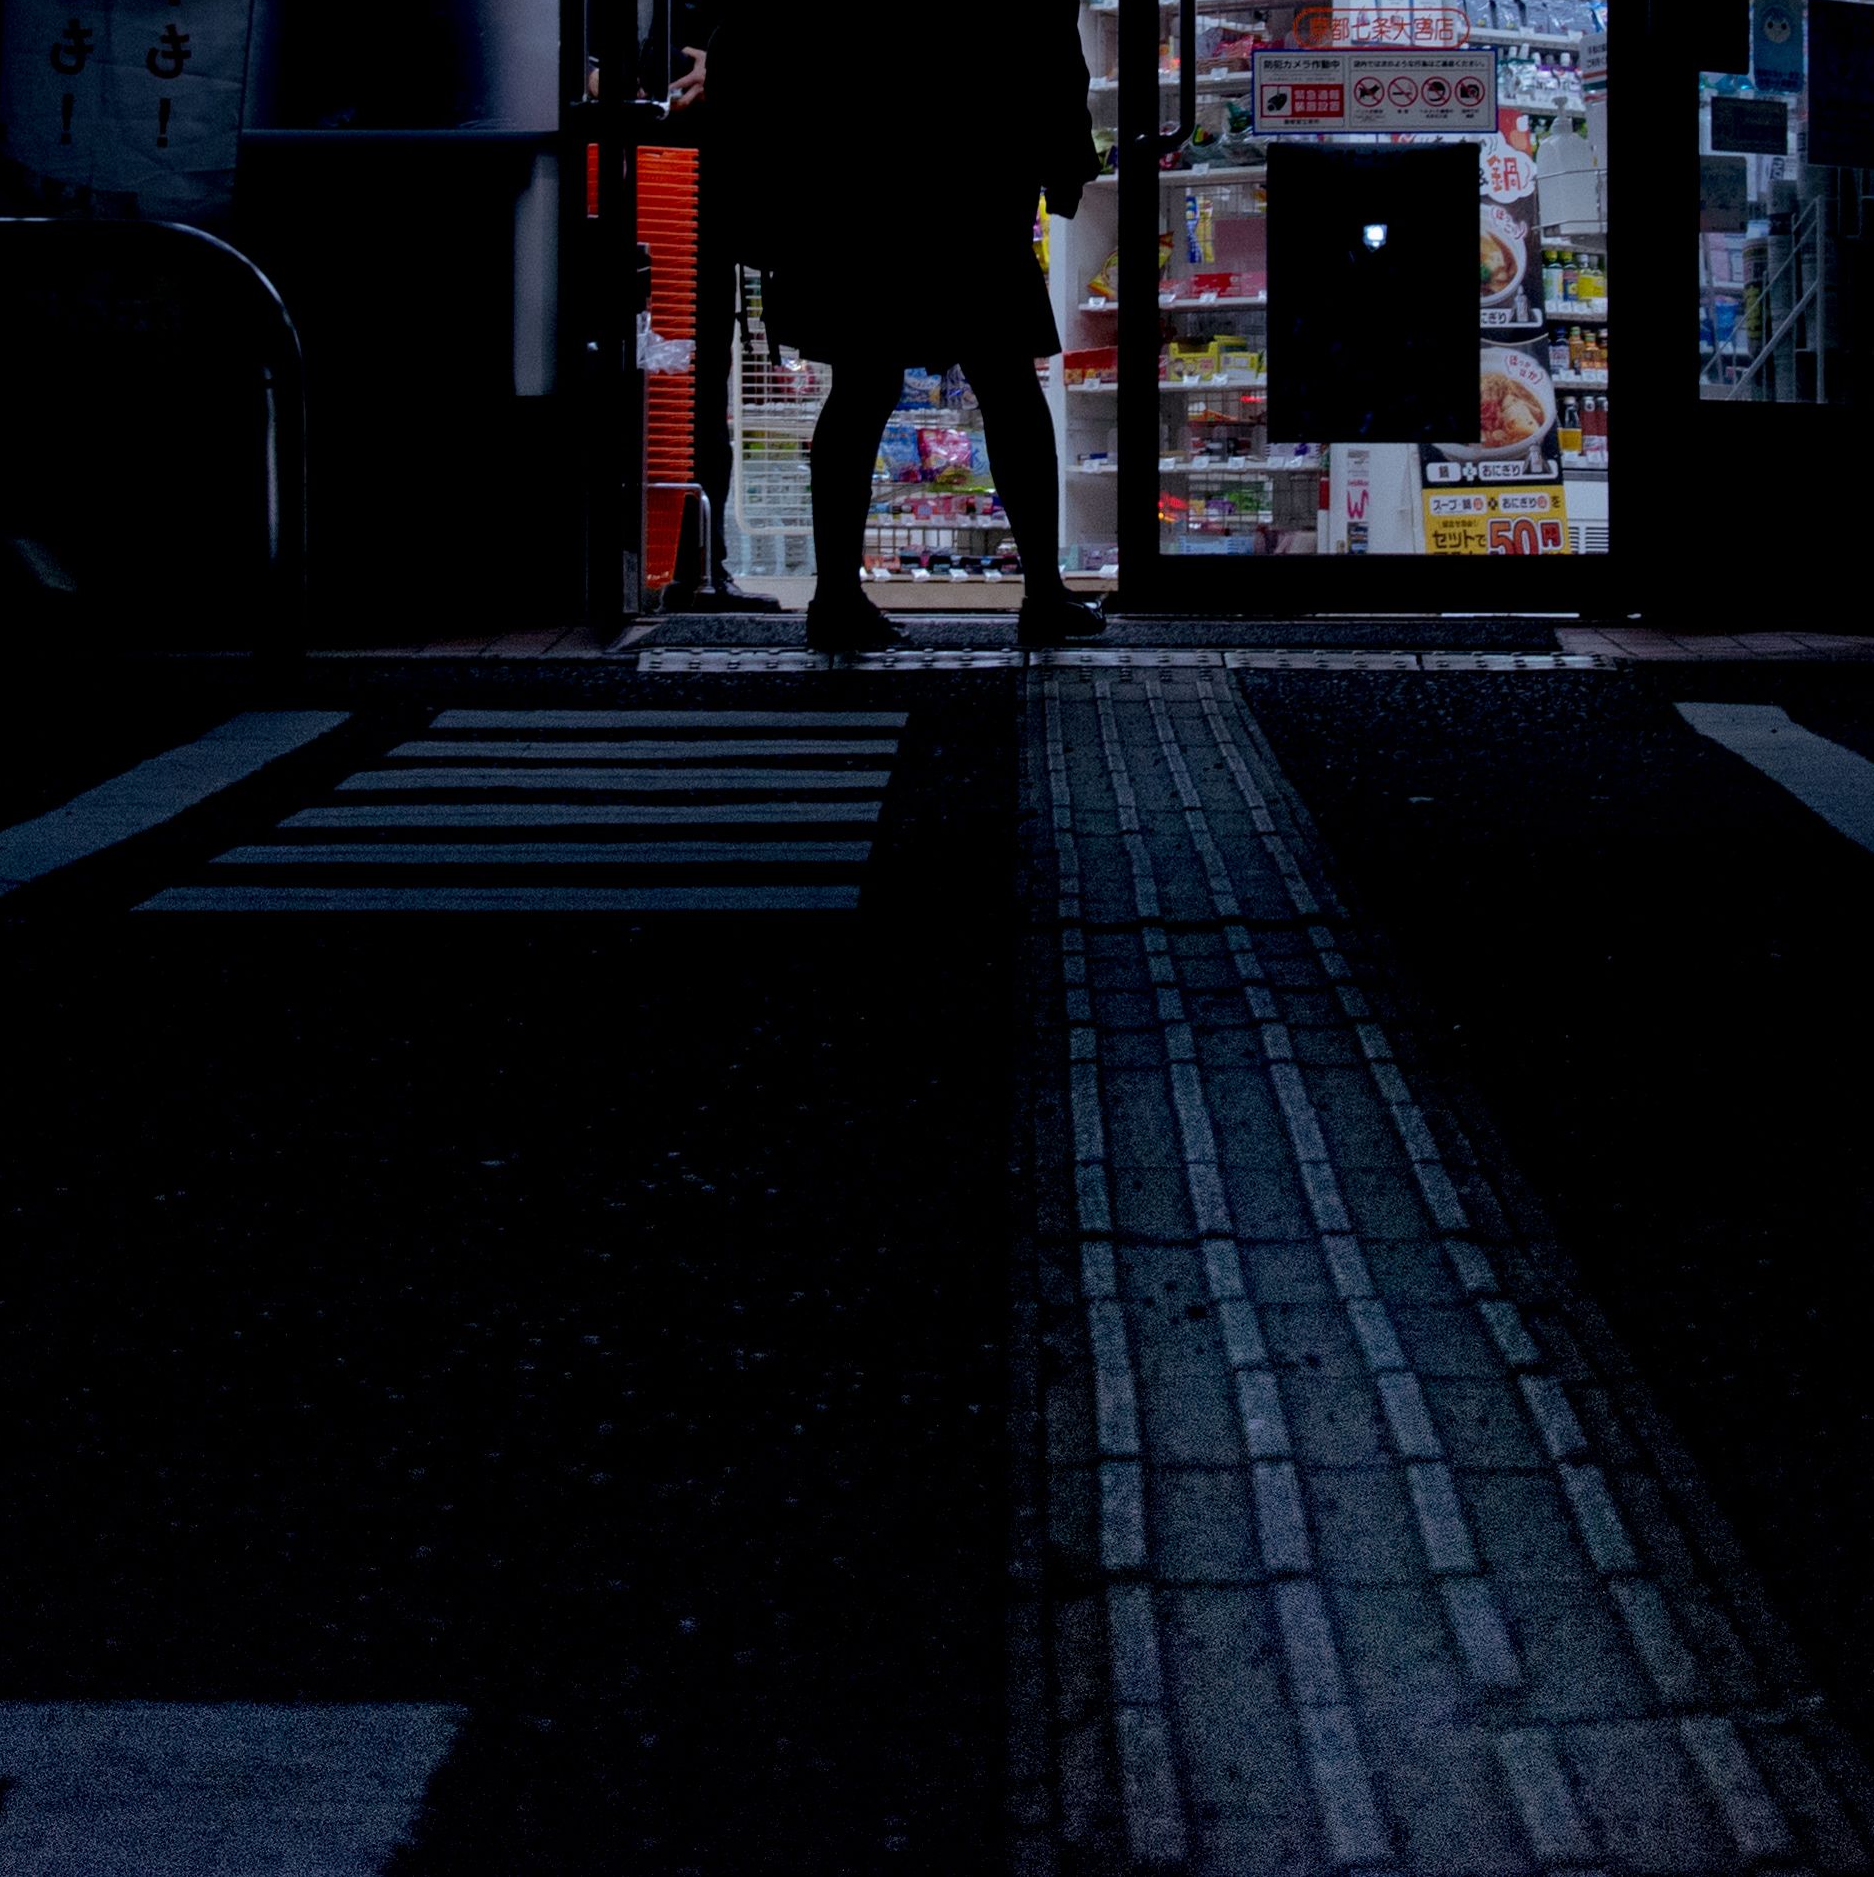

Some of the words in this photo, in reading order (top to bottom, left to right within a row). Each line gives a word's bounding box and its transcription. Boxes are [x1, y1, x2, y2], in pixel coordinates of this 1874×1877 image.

[1482, 465, 1521, 477] おにぎり
[1432, 530, 1486, 549] セットで
